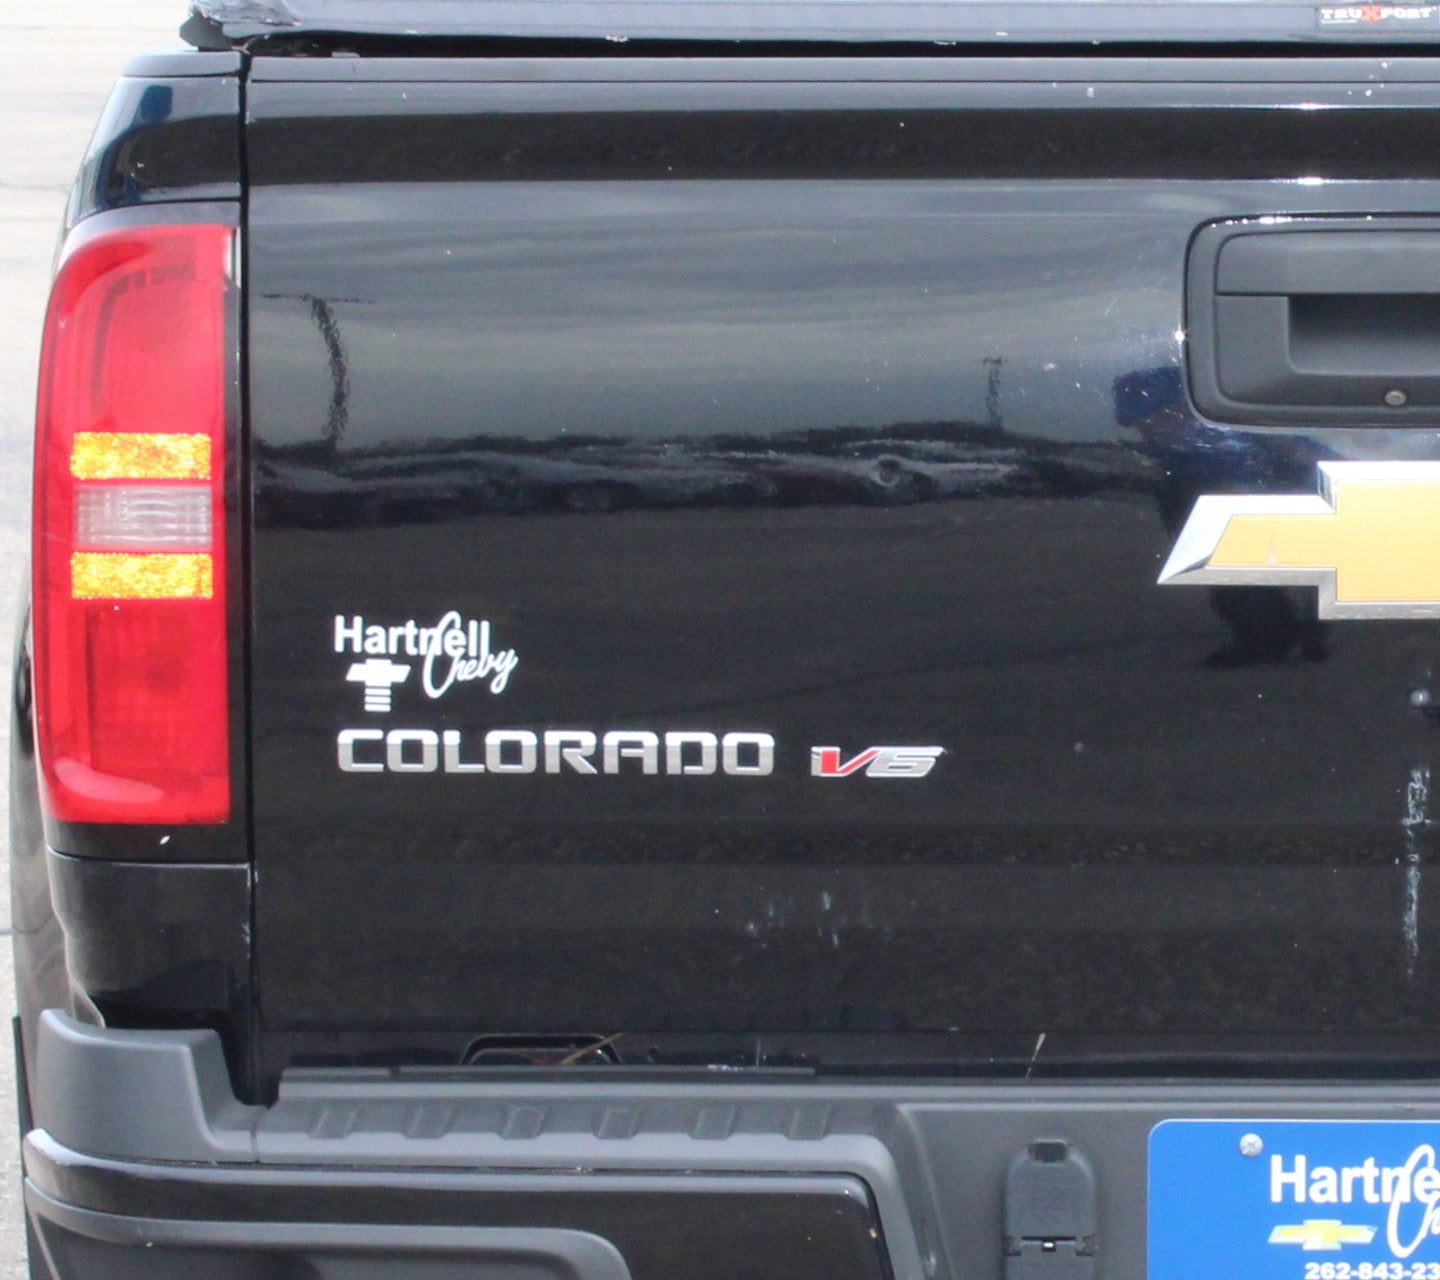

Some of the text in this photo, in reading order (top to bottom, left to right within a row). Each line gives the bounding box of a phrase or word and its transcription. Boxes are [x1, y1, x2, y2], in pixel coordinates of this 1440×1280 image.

[1320, 4, 1432, 22] TRUXPORT
[334, 615, 490, 657] Hartnell
[422, 610, 519, 699] Chevy
[337, 728, 946, 778] COLORADO V6
